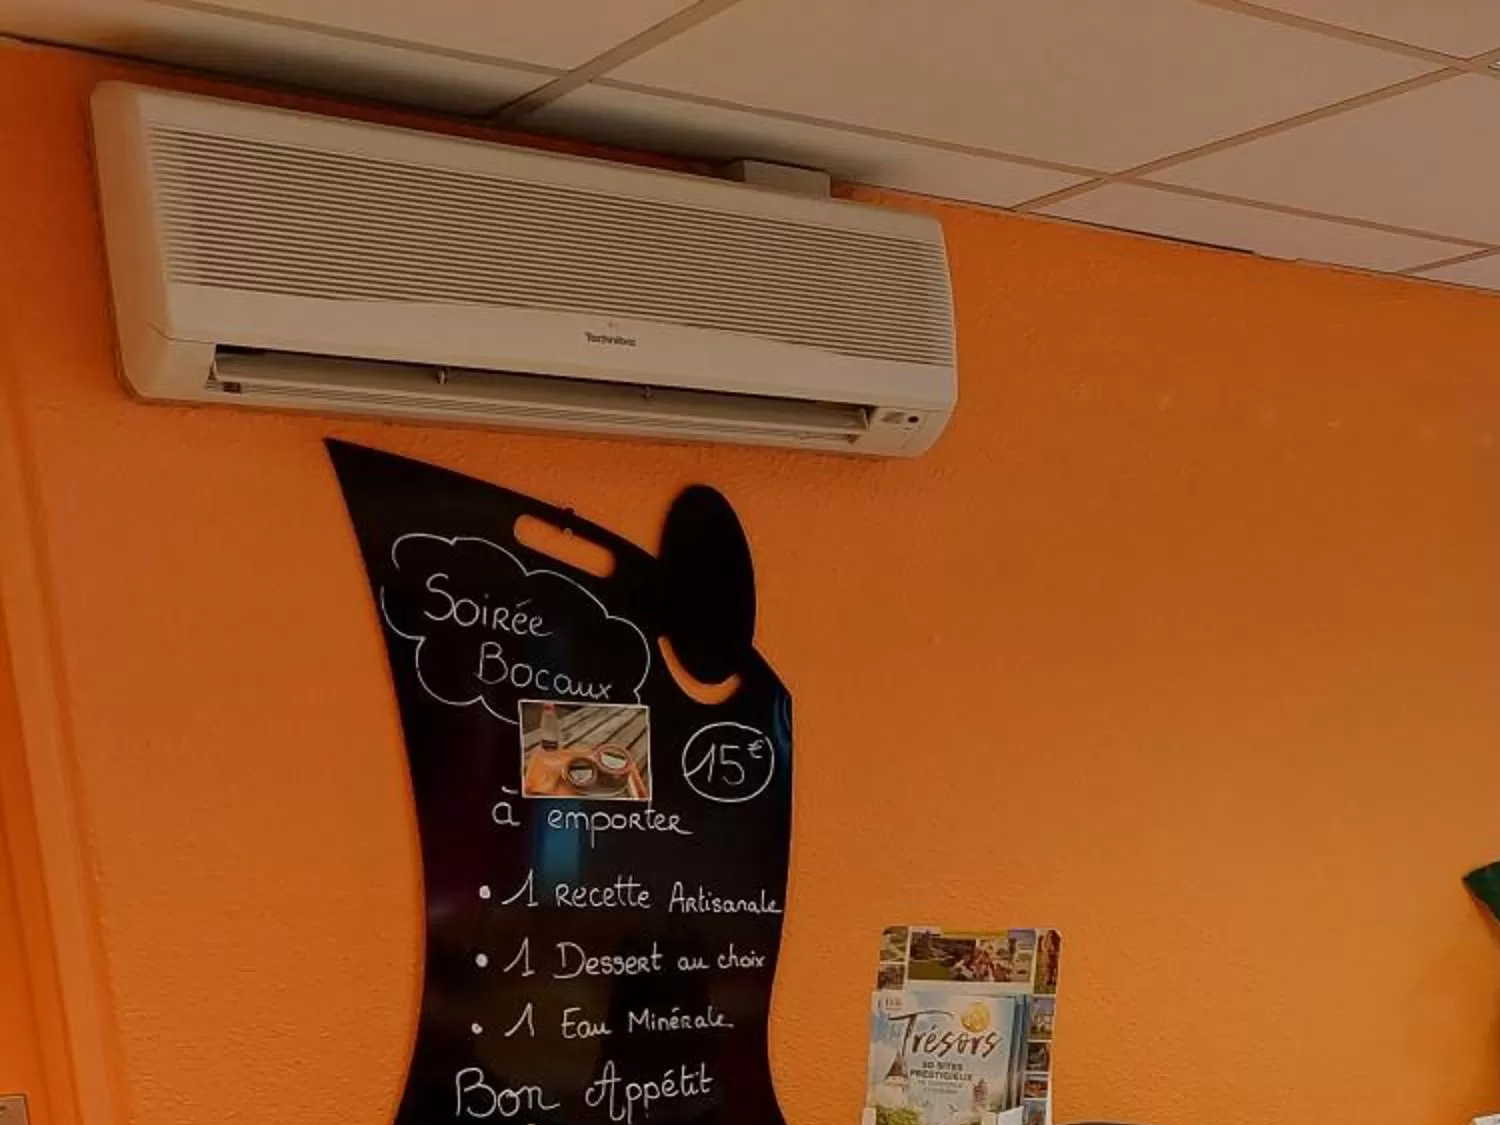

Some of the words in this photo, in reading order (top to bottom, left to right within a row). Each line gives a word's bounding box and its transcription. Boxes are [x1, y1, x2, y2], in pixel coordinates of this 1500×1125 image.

[474, 642, 612, 701] Bocaux
[492, 786, 520, 826] à
[547, 803, 693, 848] emporter
[502, 869, 538, 907] 1
[668, 881, 783, 914] Artisanale
[503, 937, 535, 976] 1
[553, 942, 663, 979] Dessert
[677, 955, 709, 971] au
[717, 942, 765, 969] choix
[504, 1002, 535, 1038] 1
[561, 1007, 612, 1039] Eau
[628, 1006, 734, 1033] Minérale
[888, 1009, 1001, 1058] Trésors
[455, 1067, 560, 1118] Bon
[585, 1060, 713, 1125] Appétit
